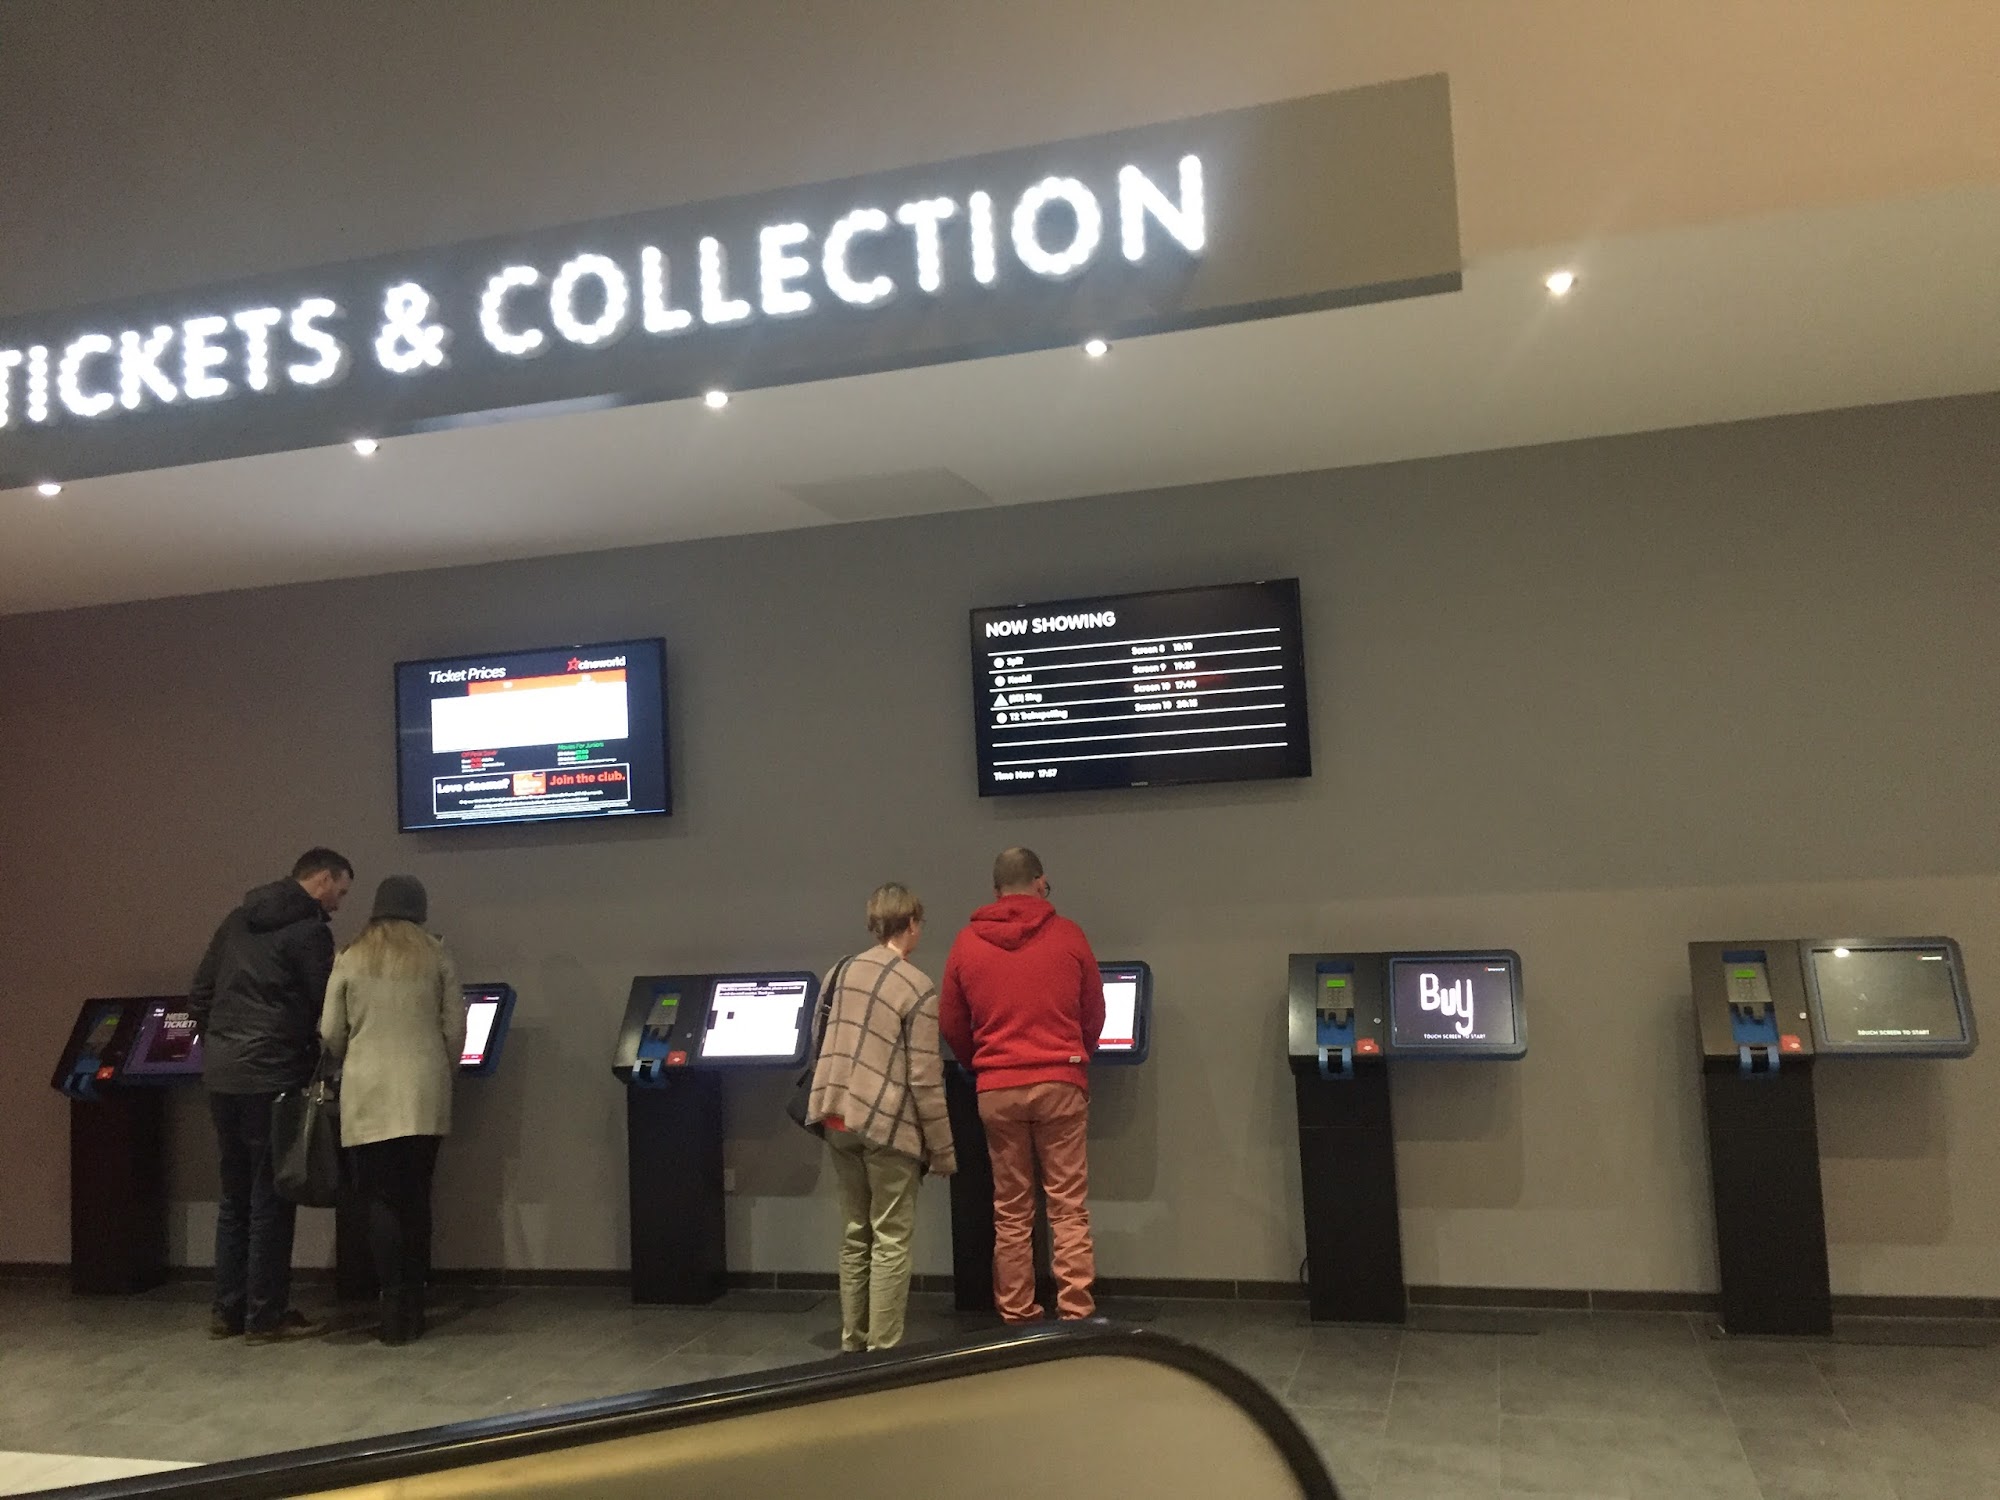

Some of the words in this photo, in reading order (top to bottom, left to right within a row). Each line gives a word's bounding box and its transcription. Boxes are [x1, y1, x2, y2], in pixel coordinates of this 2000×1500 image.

[0, 298, 340, 428] TICKETS
[375, 282, 445, 373] &
[480, 154, 1206, 355] COLLECTION
[985, 619, 1028, 638] NOW
[1031, 611, 1116, 634] SHOWING
[1131, 646, 1158, 655] Screen
[1132, 665, 1160, 674] Screen
[1160, 662, 1167, 672] 9
[429, 669, 467, 683] Ticket
[467, 666, 506, 680] Prices
[1133, 684, 1161, 693] Screen
[1134, 703, 1162, 712] Screen
[549, 775, 574, 786] Join
[574, 772, 595, 783] the
[597, 770, 626, 782] club.
[993, 771, 1014, 781] Time
[1014, 770, 1035, 780] Now
[1420, 973, 1474, 1037] Buy
[165, 1013, 189, 1021] NEED
